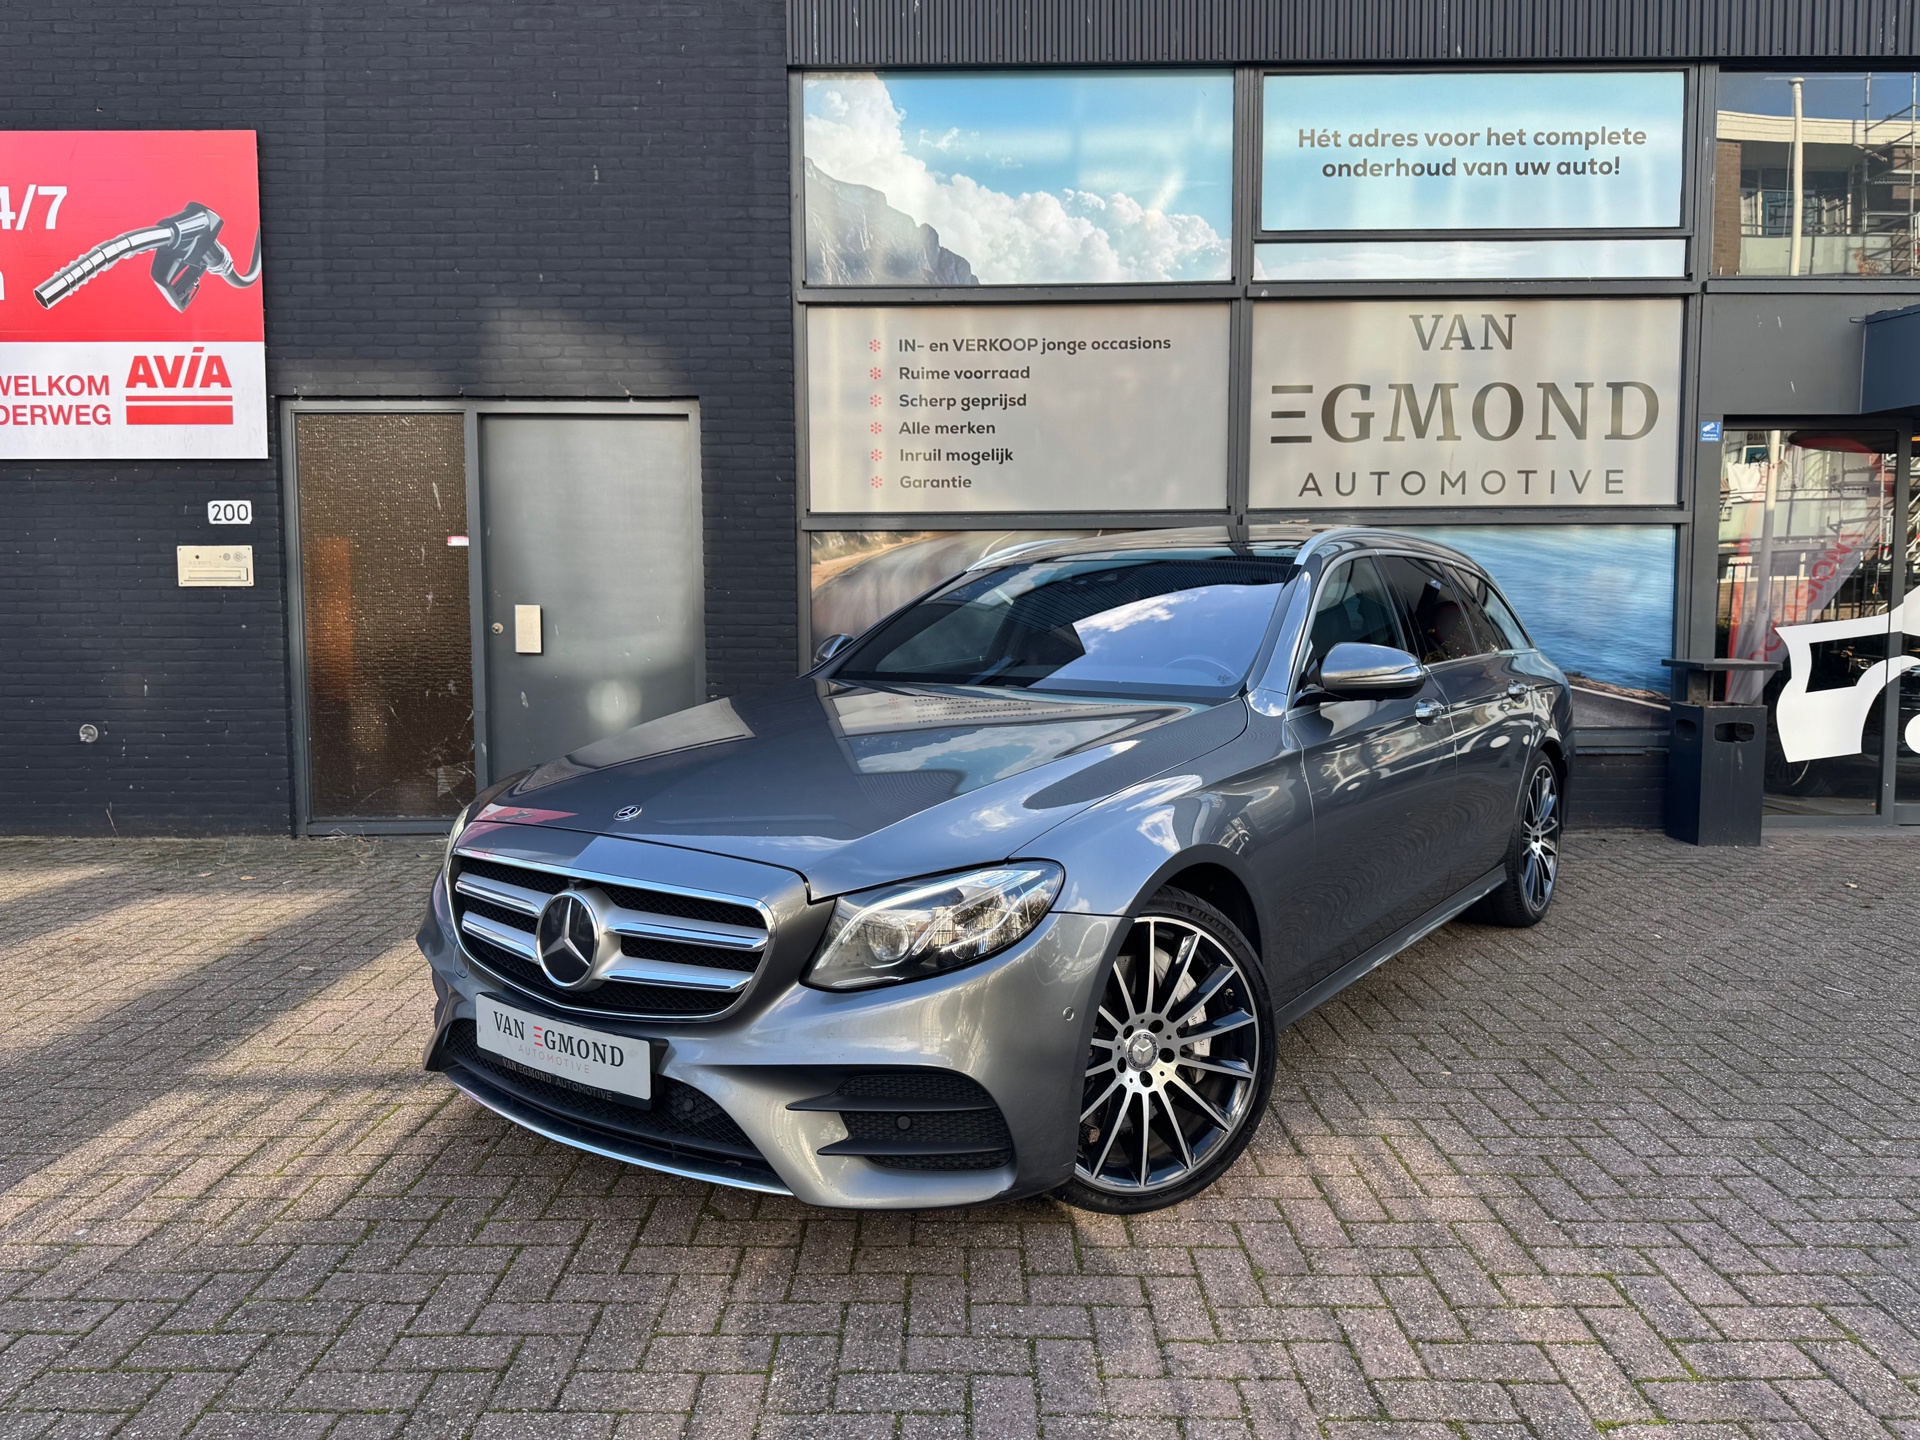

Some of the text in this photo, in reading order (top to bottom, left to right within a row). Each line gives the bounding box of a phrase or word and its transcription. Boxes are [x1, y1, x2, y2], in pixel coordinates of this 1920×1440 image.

[1299, 126, 1647, 150] Hét adres voor het complete
[1322, 156, 1620, 177] onderhoud van uw auto!
[1409, 314, 1517, 351] VAN
[899, 337, 1171, 355] IN- en VERKOOP jonge occasions
[899, 366, 1030, 380] Ruime voorraad
[899, 394, 1027, 411] Scherp geprijsd
[1271, 380, 1660, 444] EGMOND
[899, 421, 996, 435] Alle merken
[900, 448, 1013, 466] Inruil mogelijk
[900, 475, 972, 489] Garantie
[1298, 469, 1625, 498] AUTOMOTIVE
[212, 504, 249, 521] 200
[493, 1011, 625, 1067] VAN EGMOND
[518, 1044, 590, 1074] AUTOMOTIVE
[502, 1057, 517, 1072] VAN
[556, 1077, 613, 1101] AUTOMOTIVE
